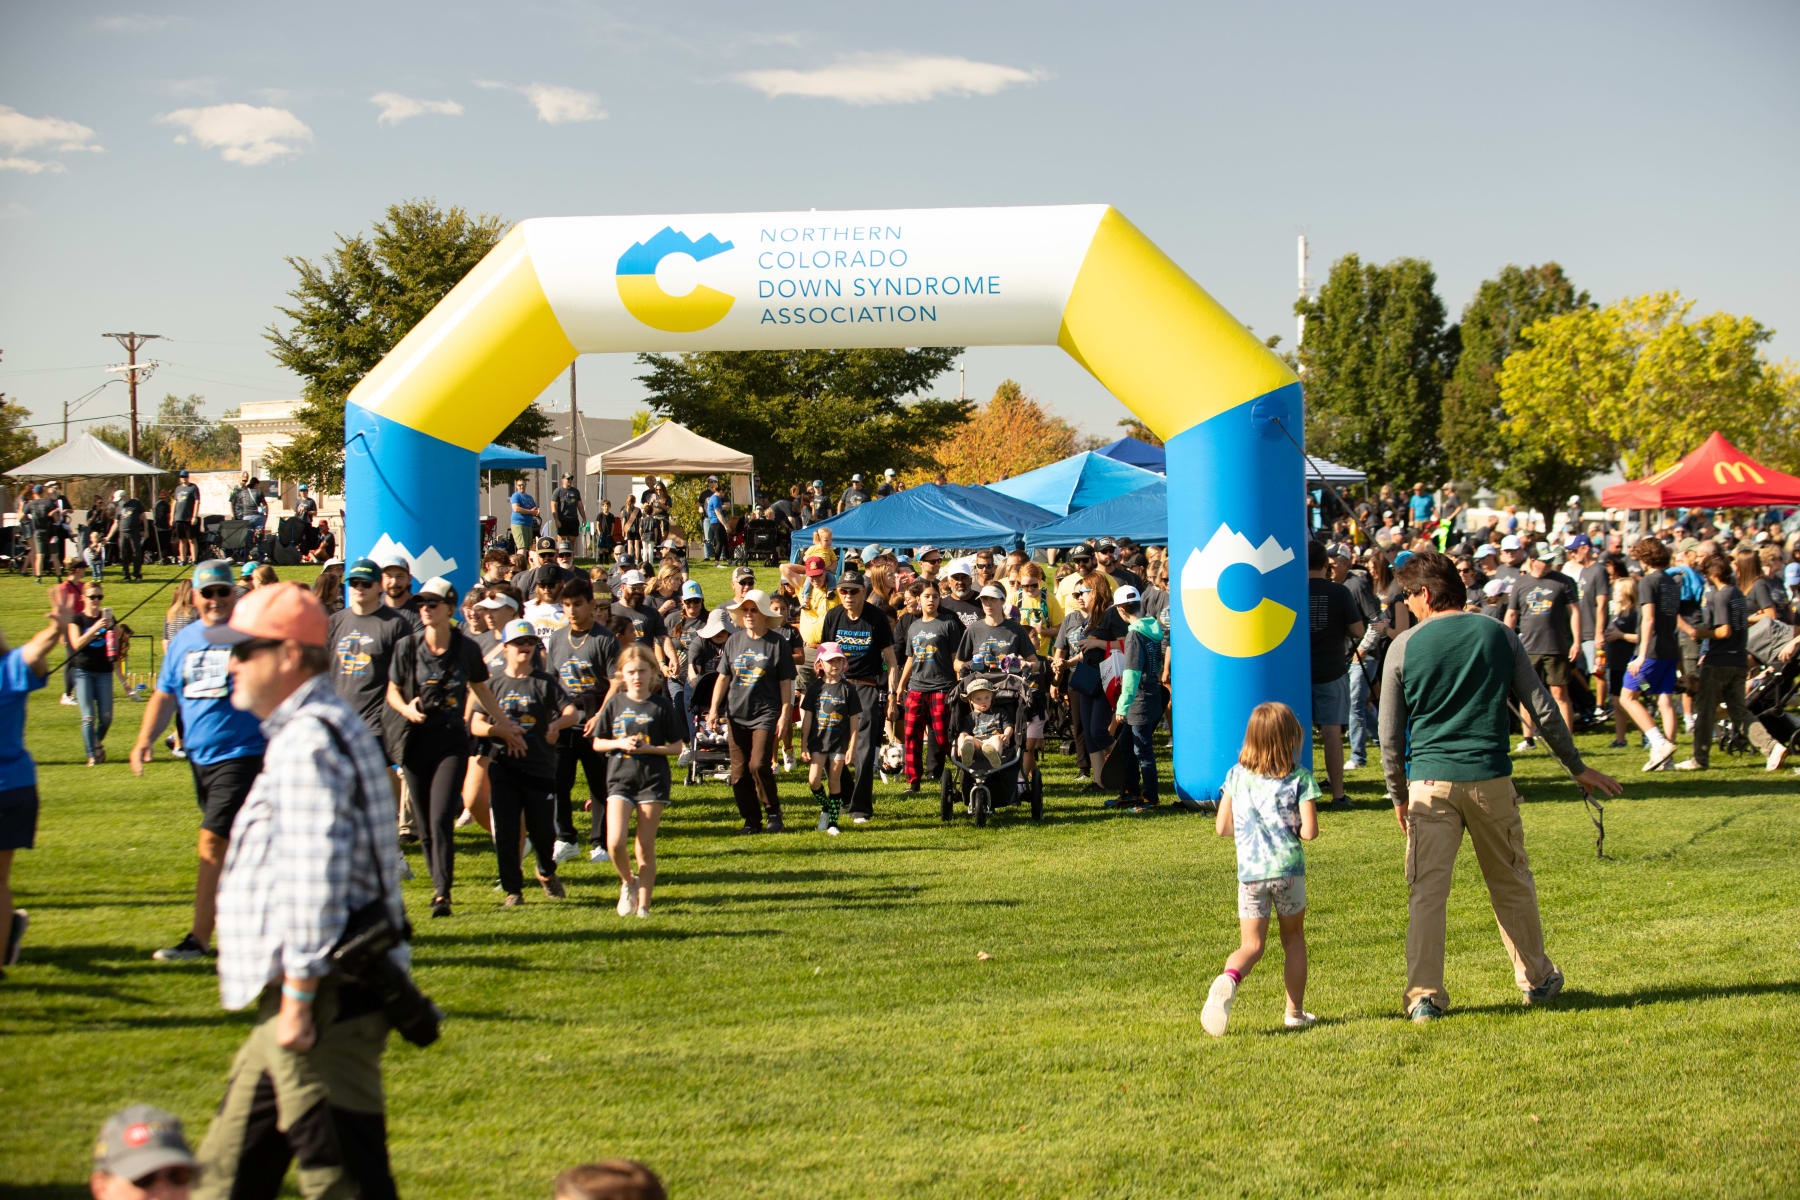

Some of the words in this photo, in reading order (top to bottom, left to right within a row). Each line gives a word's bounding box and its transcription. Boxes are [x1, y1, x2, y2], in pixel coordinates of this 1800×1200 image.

[760, 226, 902, 242] NORTHERN
[758, 249, 908, 270] COLORADO
[759, 278, 841, 298] DOWN
[853, 276, 1001, 297] SYNDROME
[760, 305, 937, 325] ASSOCIATION
